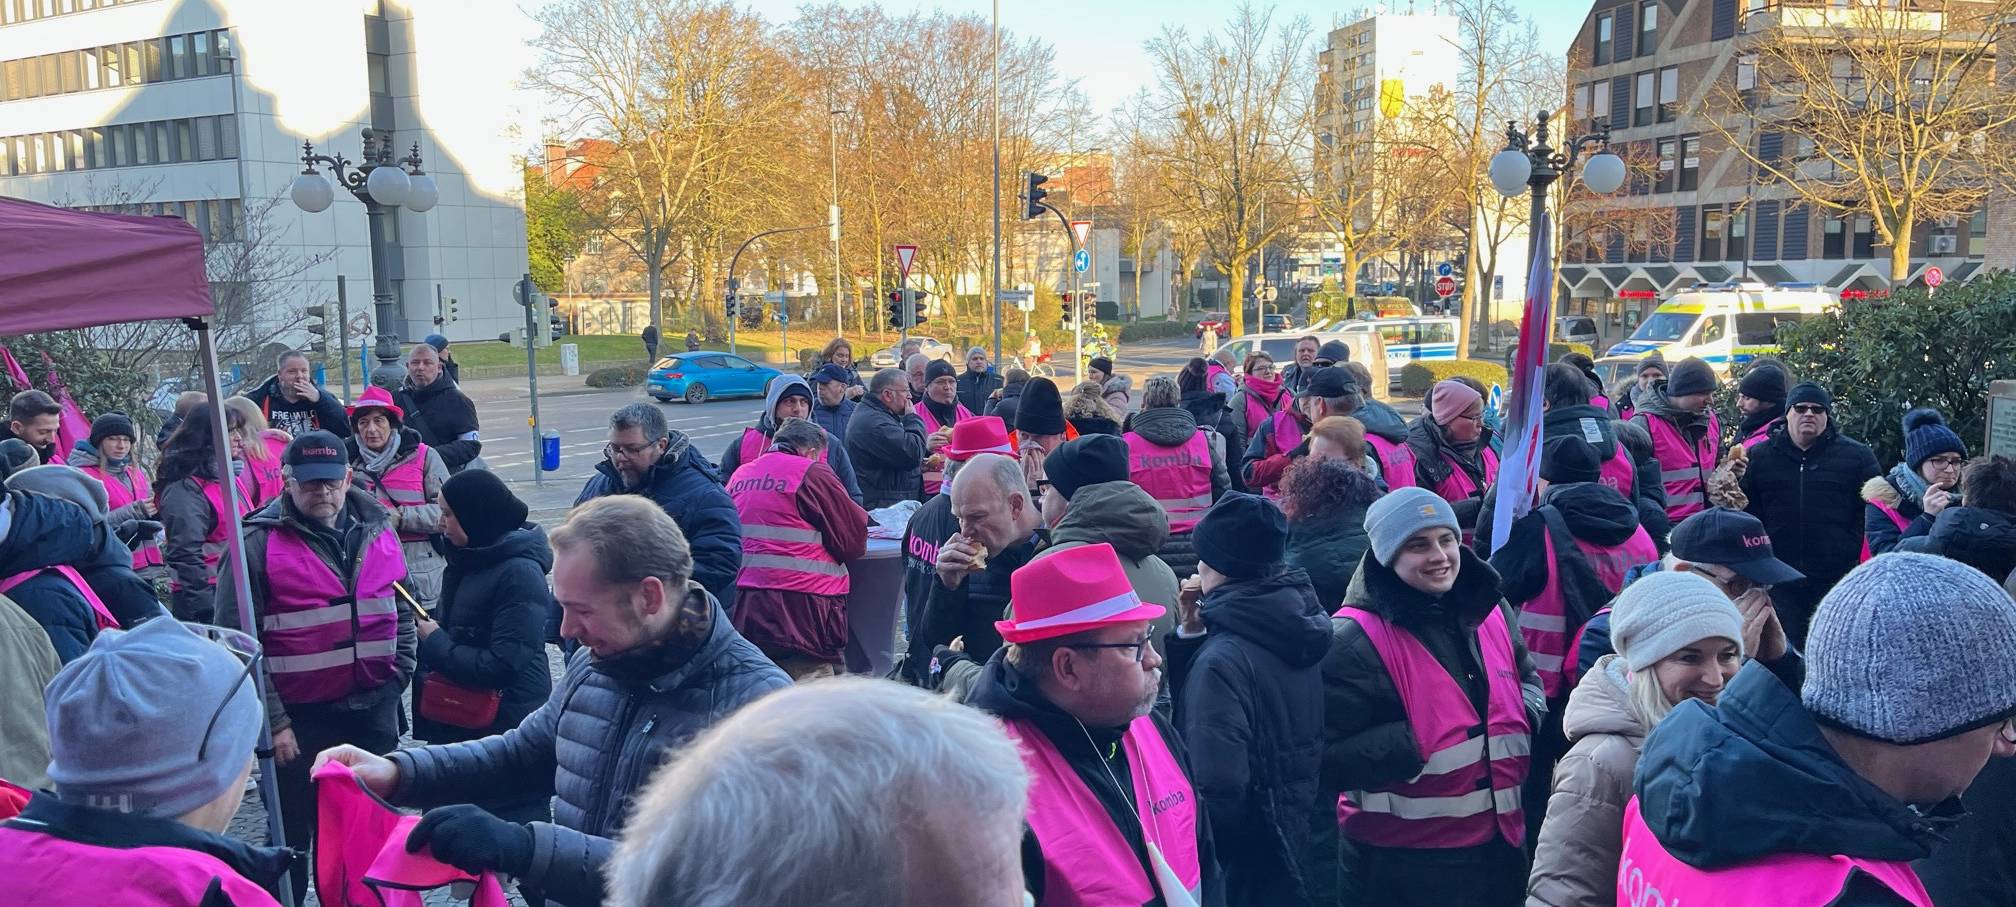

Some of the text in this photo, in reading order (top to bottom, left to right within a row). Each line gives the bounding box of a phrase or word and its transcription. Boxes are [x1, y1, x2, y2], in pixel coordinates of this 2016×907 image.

[1437, 281, 1454, 291] STOP
[302, 447, 337, 457] komba
[1147, 790, 1185, 815] komba
[1618, 859, 1680, 907] kom
